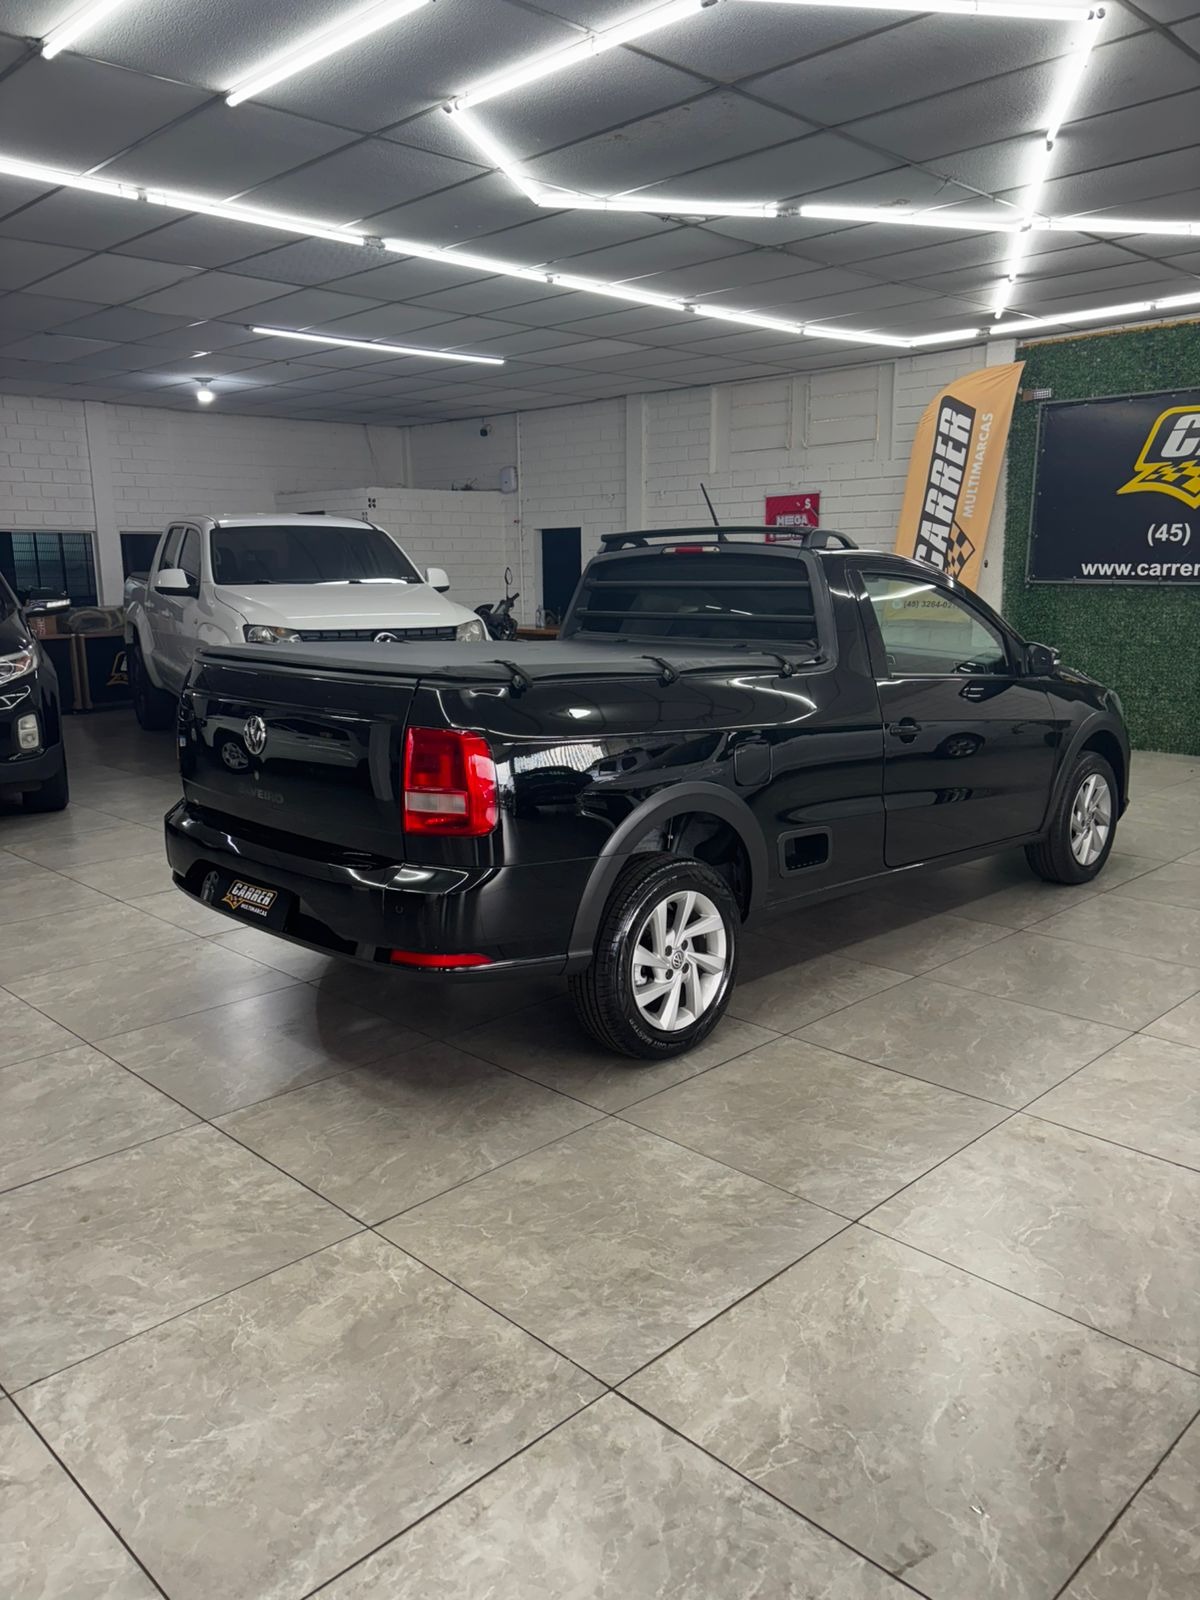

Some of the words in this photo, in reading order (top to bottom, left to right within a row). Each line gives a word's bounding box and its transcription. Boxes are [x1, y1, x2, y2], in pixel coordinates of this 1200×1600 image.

[1160, 413, 1200, 458] C
[962, 412, 994, 518] MULTIMARCAS
[915, 407, 972, 571] CARRER
[1147, 523, 1191, 547] (45)
[1081, 562, 1200, 577] www.carrer
[231, 882, 274, 906] CARRER
